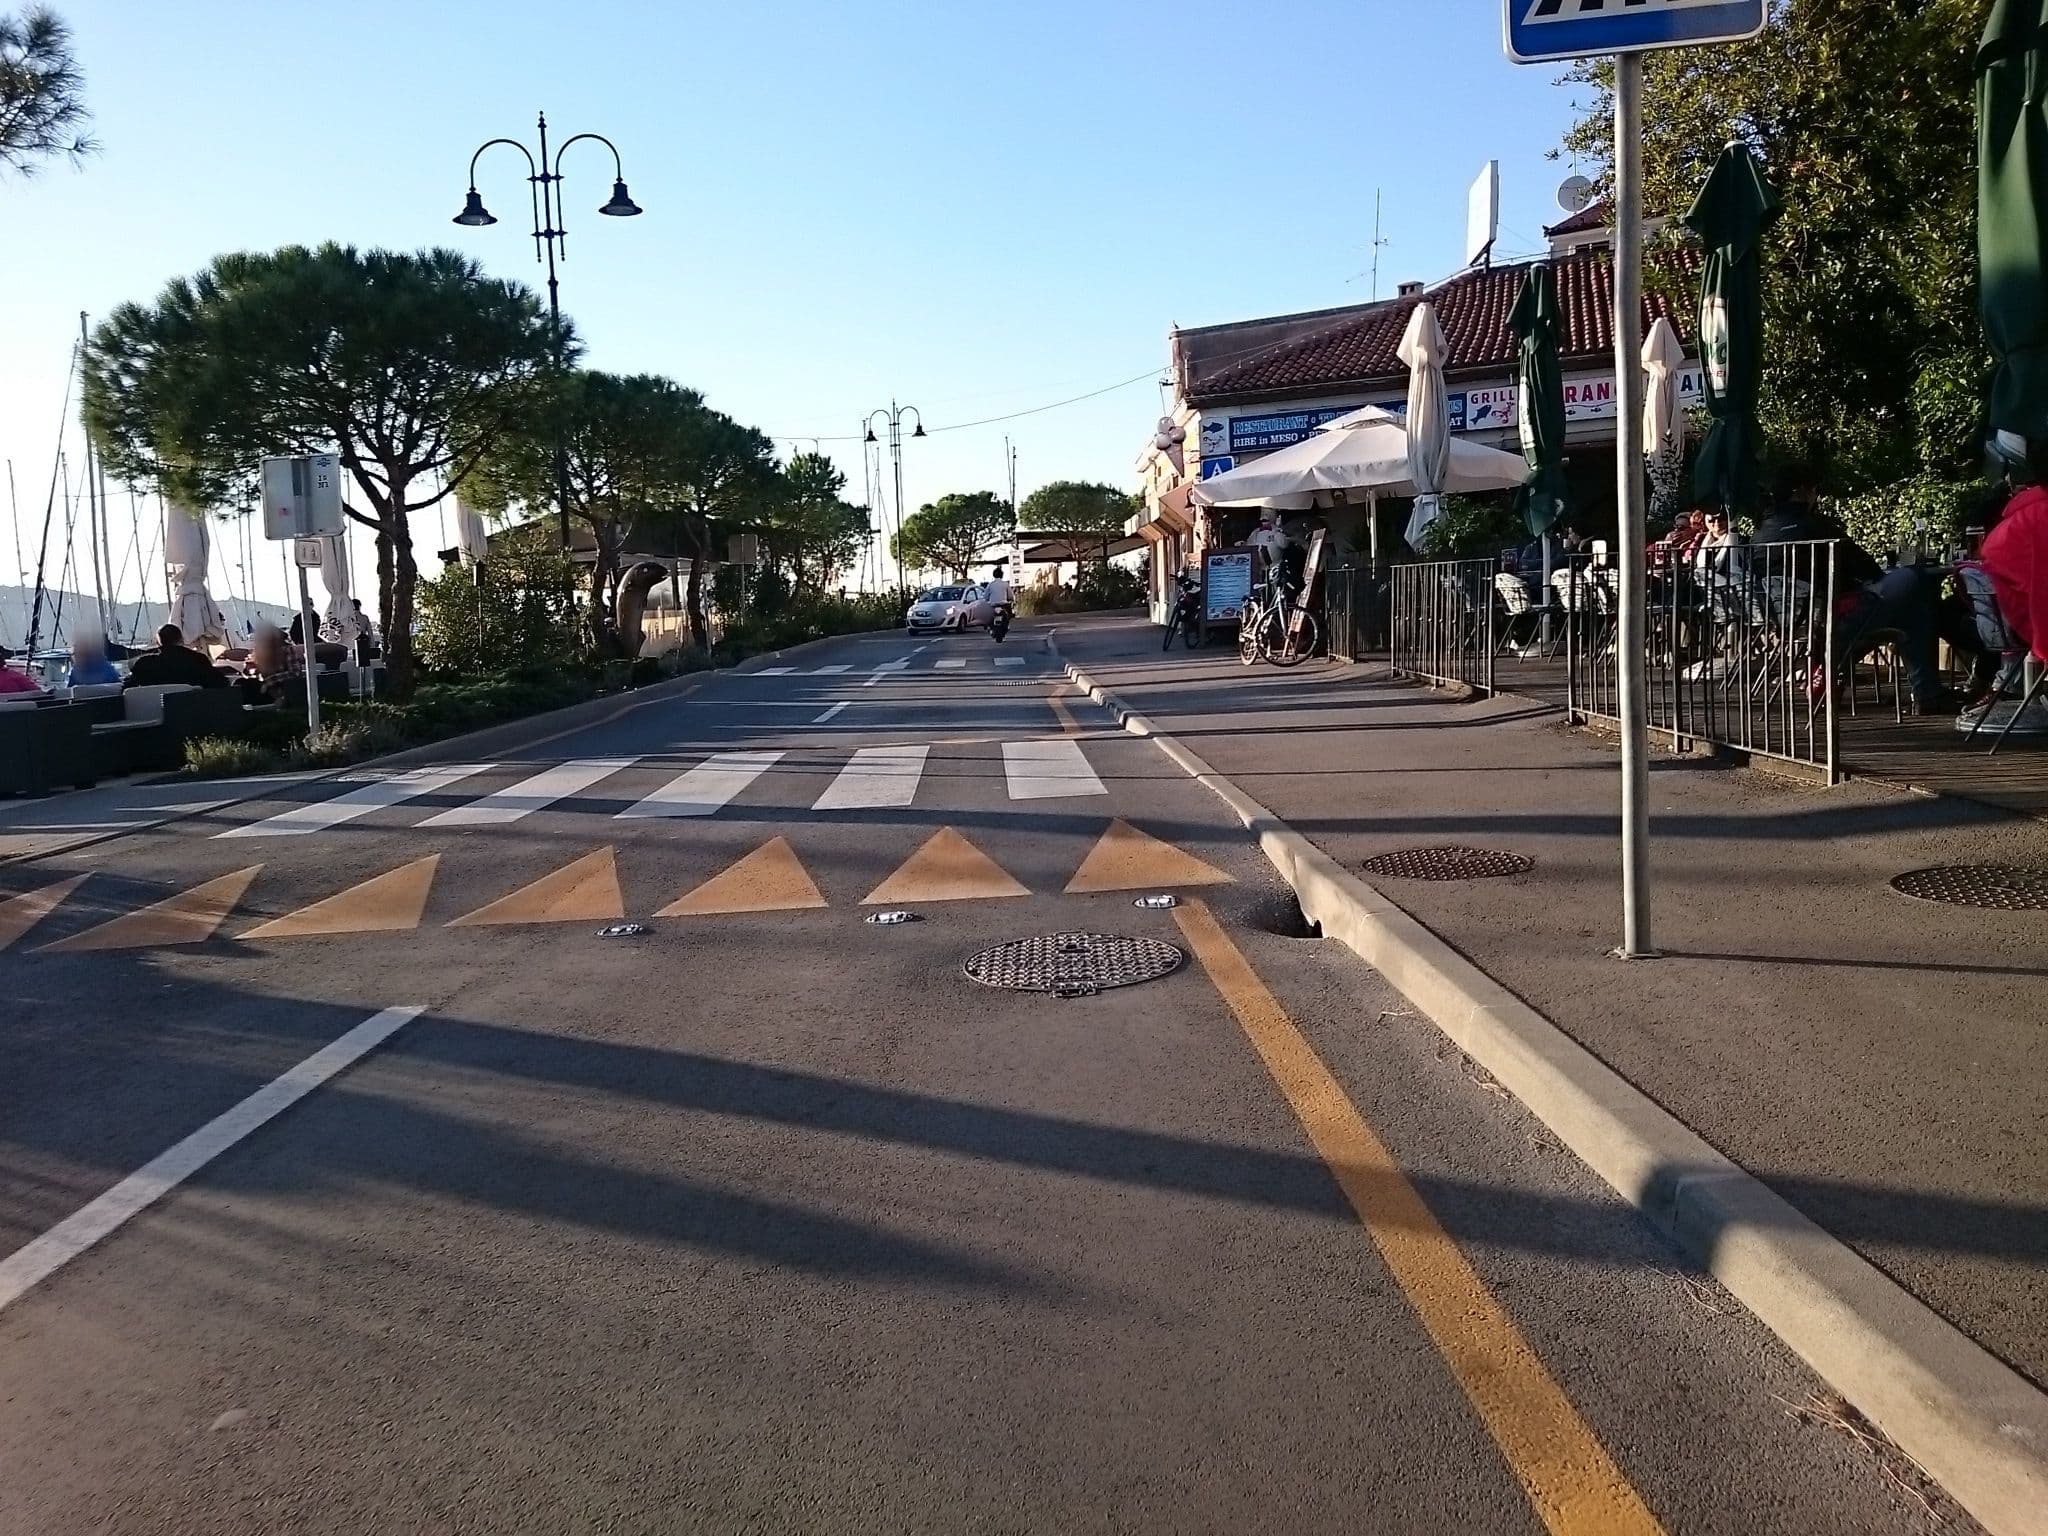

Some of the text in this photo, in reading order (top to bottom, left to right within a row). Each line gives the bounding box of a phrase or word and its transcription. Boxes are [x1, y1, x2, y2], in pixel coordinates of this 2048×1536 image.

[1471, 389, 1515, 405] GRILL
[1565, 382, 1616, 403] RAN
[1233, 415, 1308, 435] RESTAURANT
[1233, 437, 1256, 448] RIBE
[1270, 433, 1298, 444] MESO
